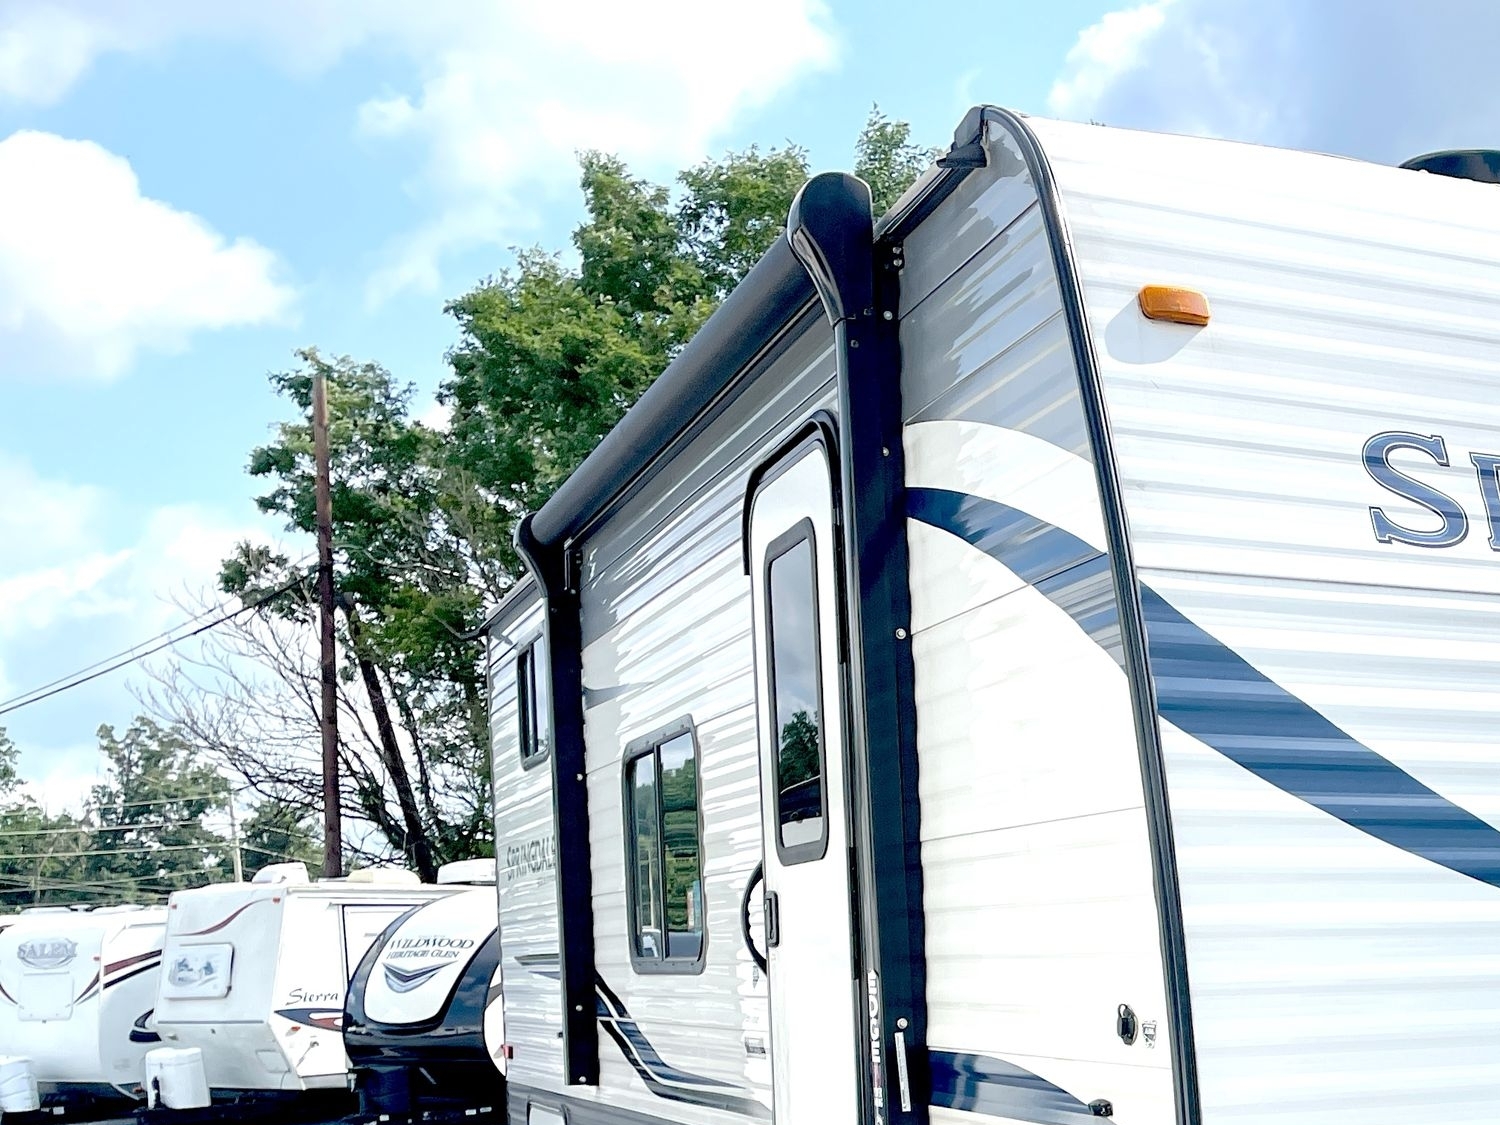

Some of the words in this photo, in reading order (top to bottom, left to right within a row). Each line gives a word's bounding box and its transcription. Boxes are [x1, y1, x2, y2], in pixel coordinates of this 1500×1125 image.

[17, 943, 78, 959] SALEM
[390, 938, 475, 949] WILDWOOD
[285, 988, 338, 1006] Sierra
